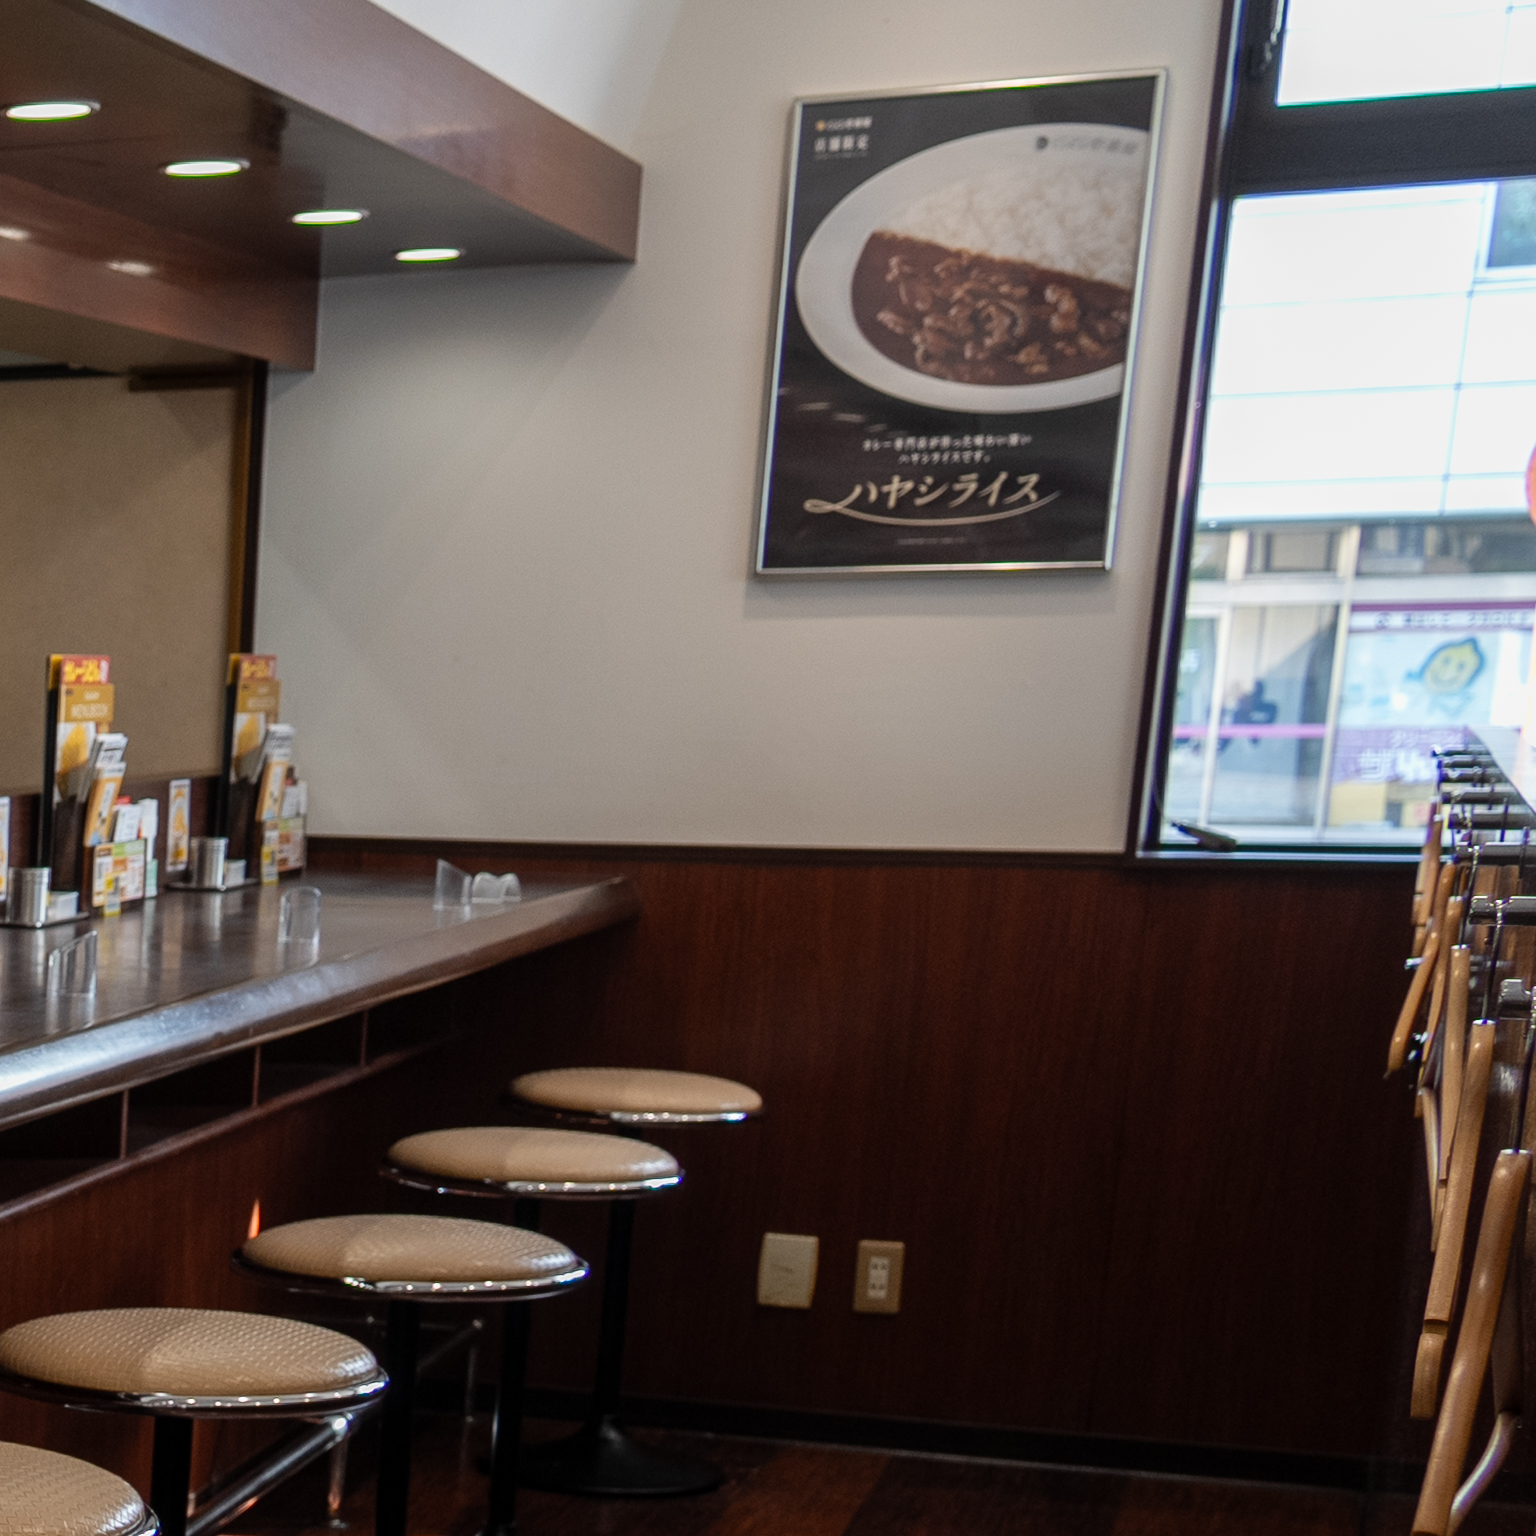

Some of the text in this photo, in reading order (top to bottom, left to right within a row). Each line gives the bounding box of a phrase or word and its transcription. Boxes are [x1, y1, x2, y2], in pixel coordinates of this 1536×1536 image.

[826, 470, 1044, 512] ハヤシライス
